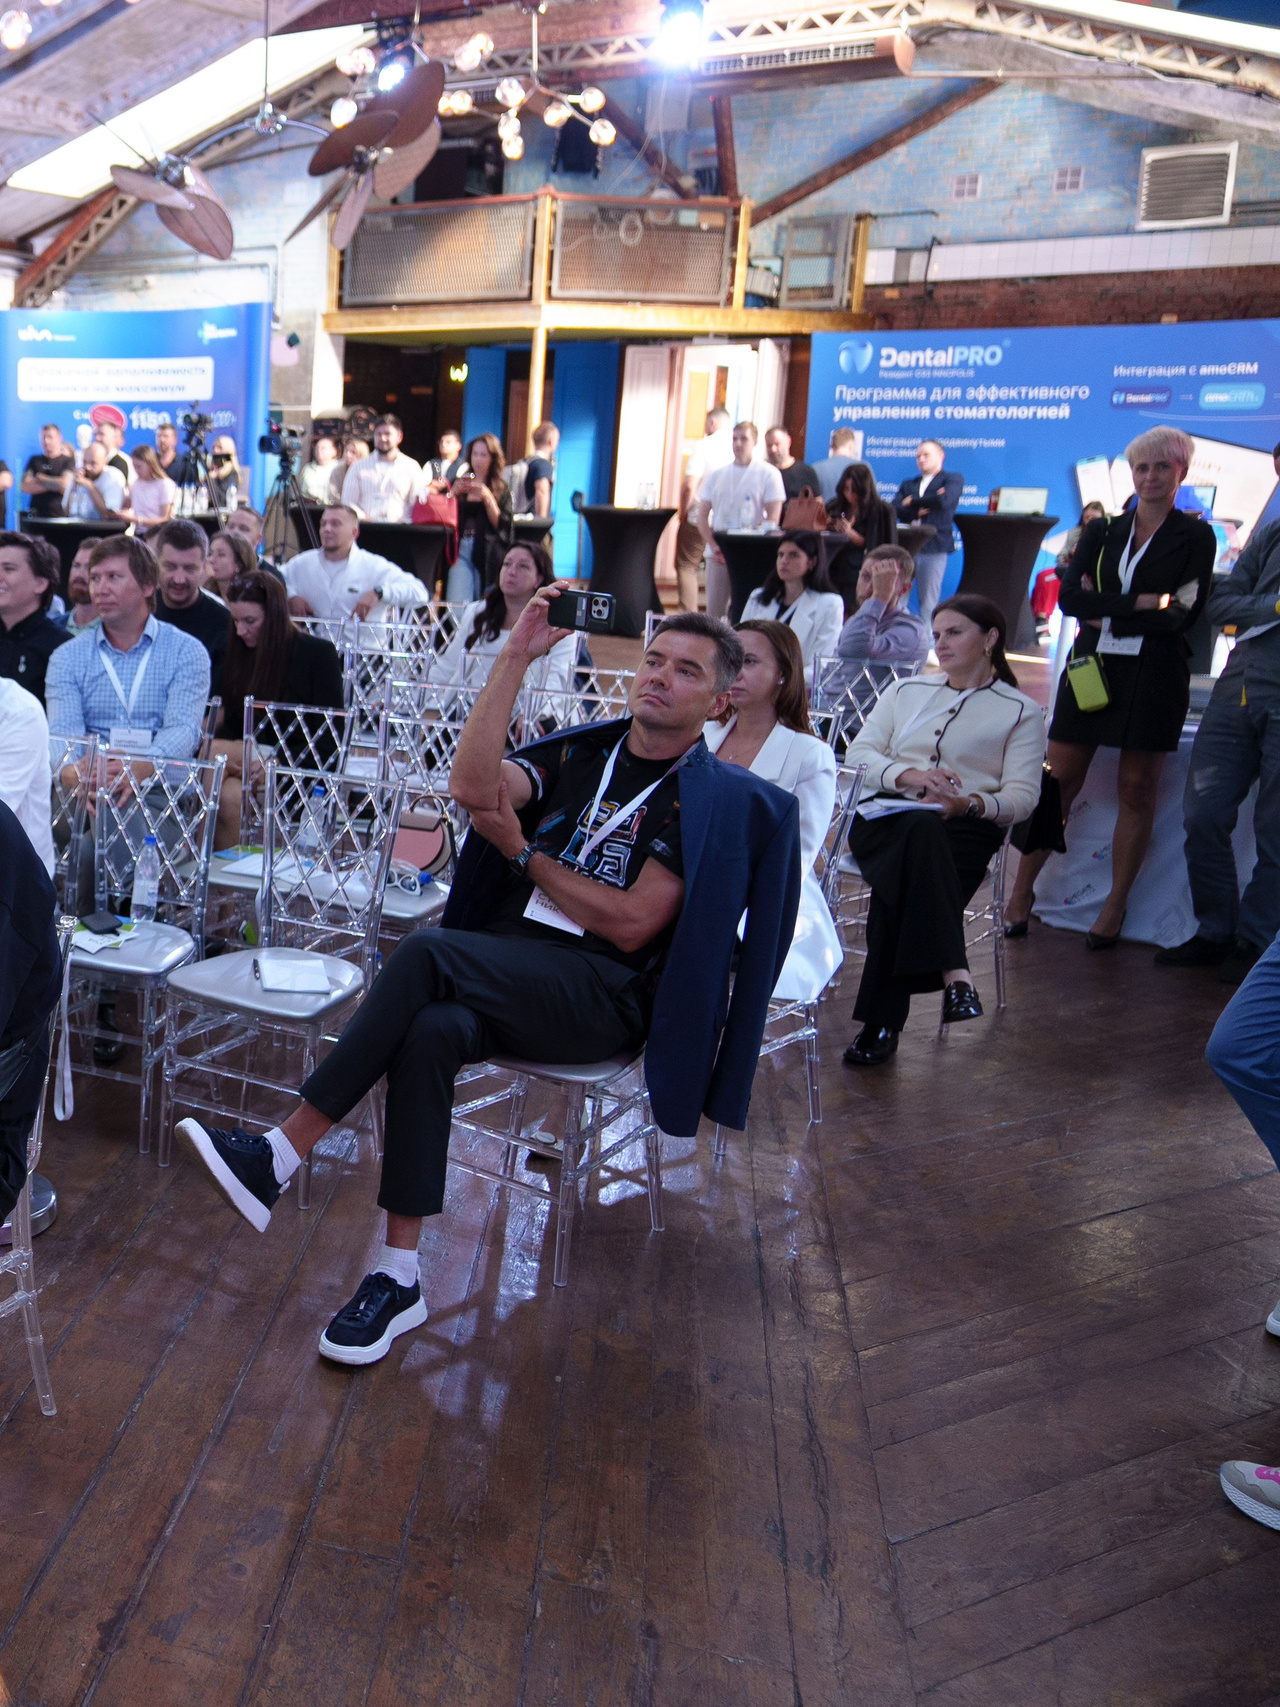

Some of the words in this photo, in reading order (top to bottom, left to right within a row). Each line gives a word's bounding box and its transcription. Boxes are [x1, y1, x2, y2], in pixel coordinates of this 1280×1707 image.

[879, 345, 1003, 368] DentalPRO
[1113, 364, 1187, 379] Интеграция
[1199, 362, 1259, 375] amoCRM
[835, 385, 927, 404] Программа
[930, 387, 962, 403] для
[965, 384, 1090, 402] эффективного
[833, 405, 931, 423] управления
[934, 402, 1070, 420] стоматологией
